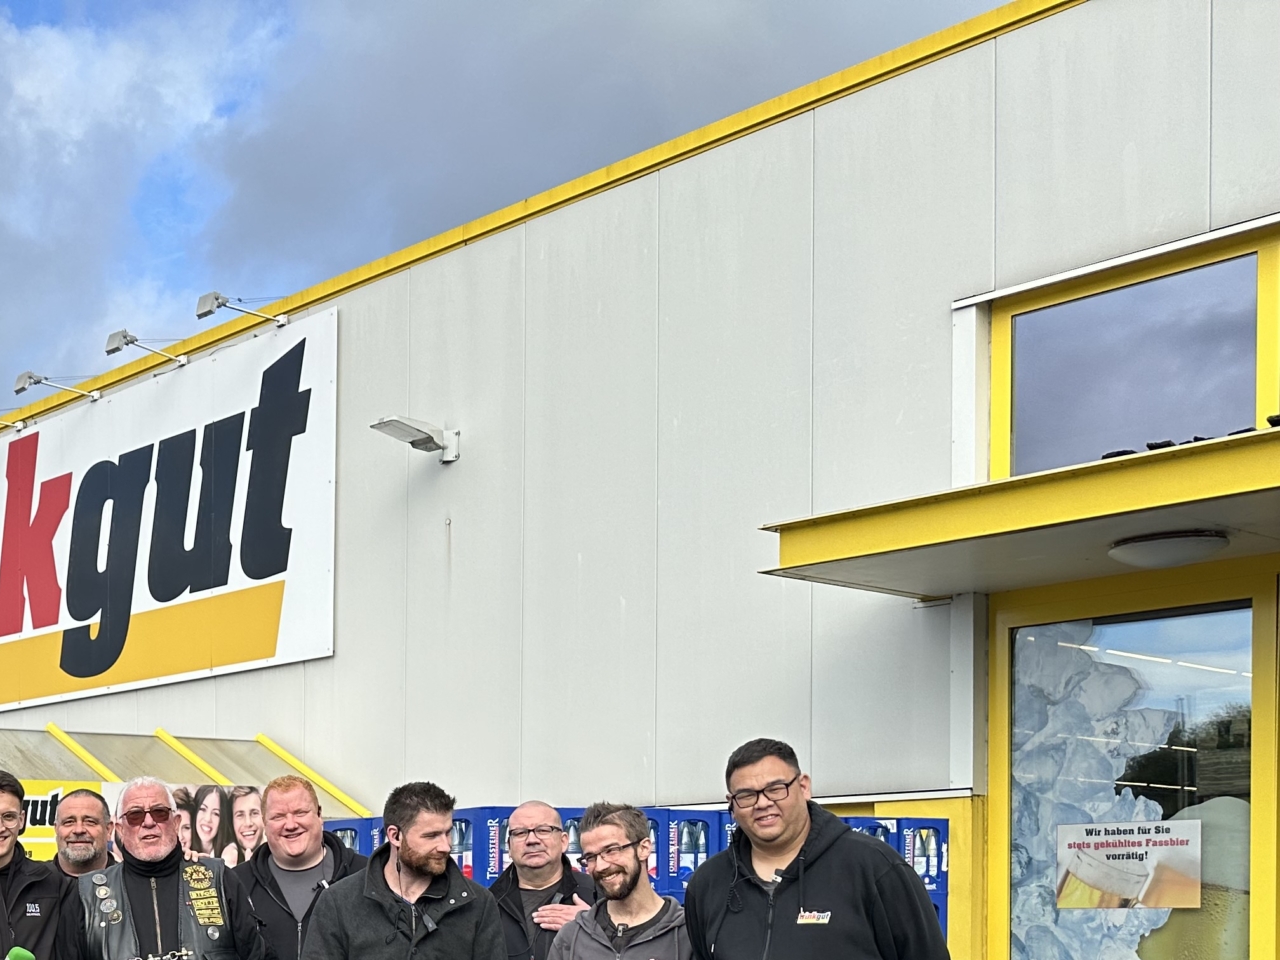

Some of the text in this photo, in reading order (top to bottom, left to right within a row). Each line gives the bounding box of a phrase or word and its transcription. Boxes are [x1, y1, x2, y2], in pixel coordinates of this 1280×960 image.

[1085, 825, 1171, 837] Wir haben für Sie
[1067, 837, 1190, 850] stets gekühltes Fassbier
[1105, 851, 1148, 862] vorrätig!
